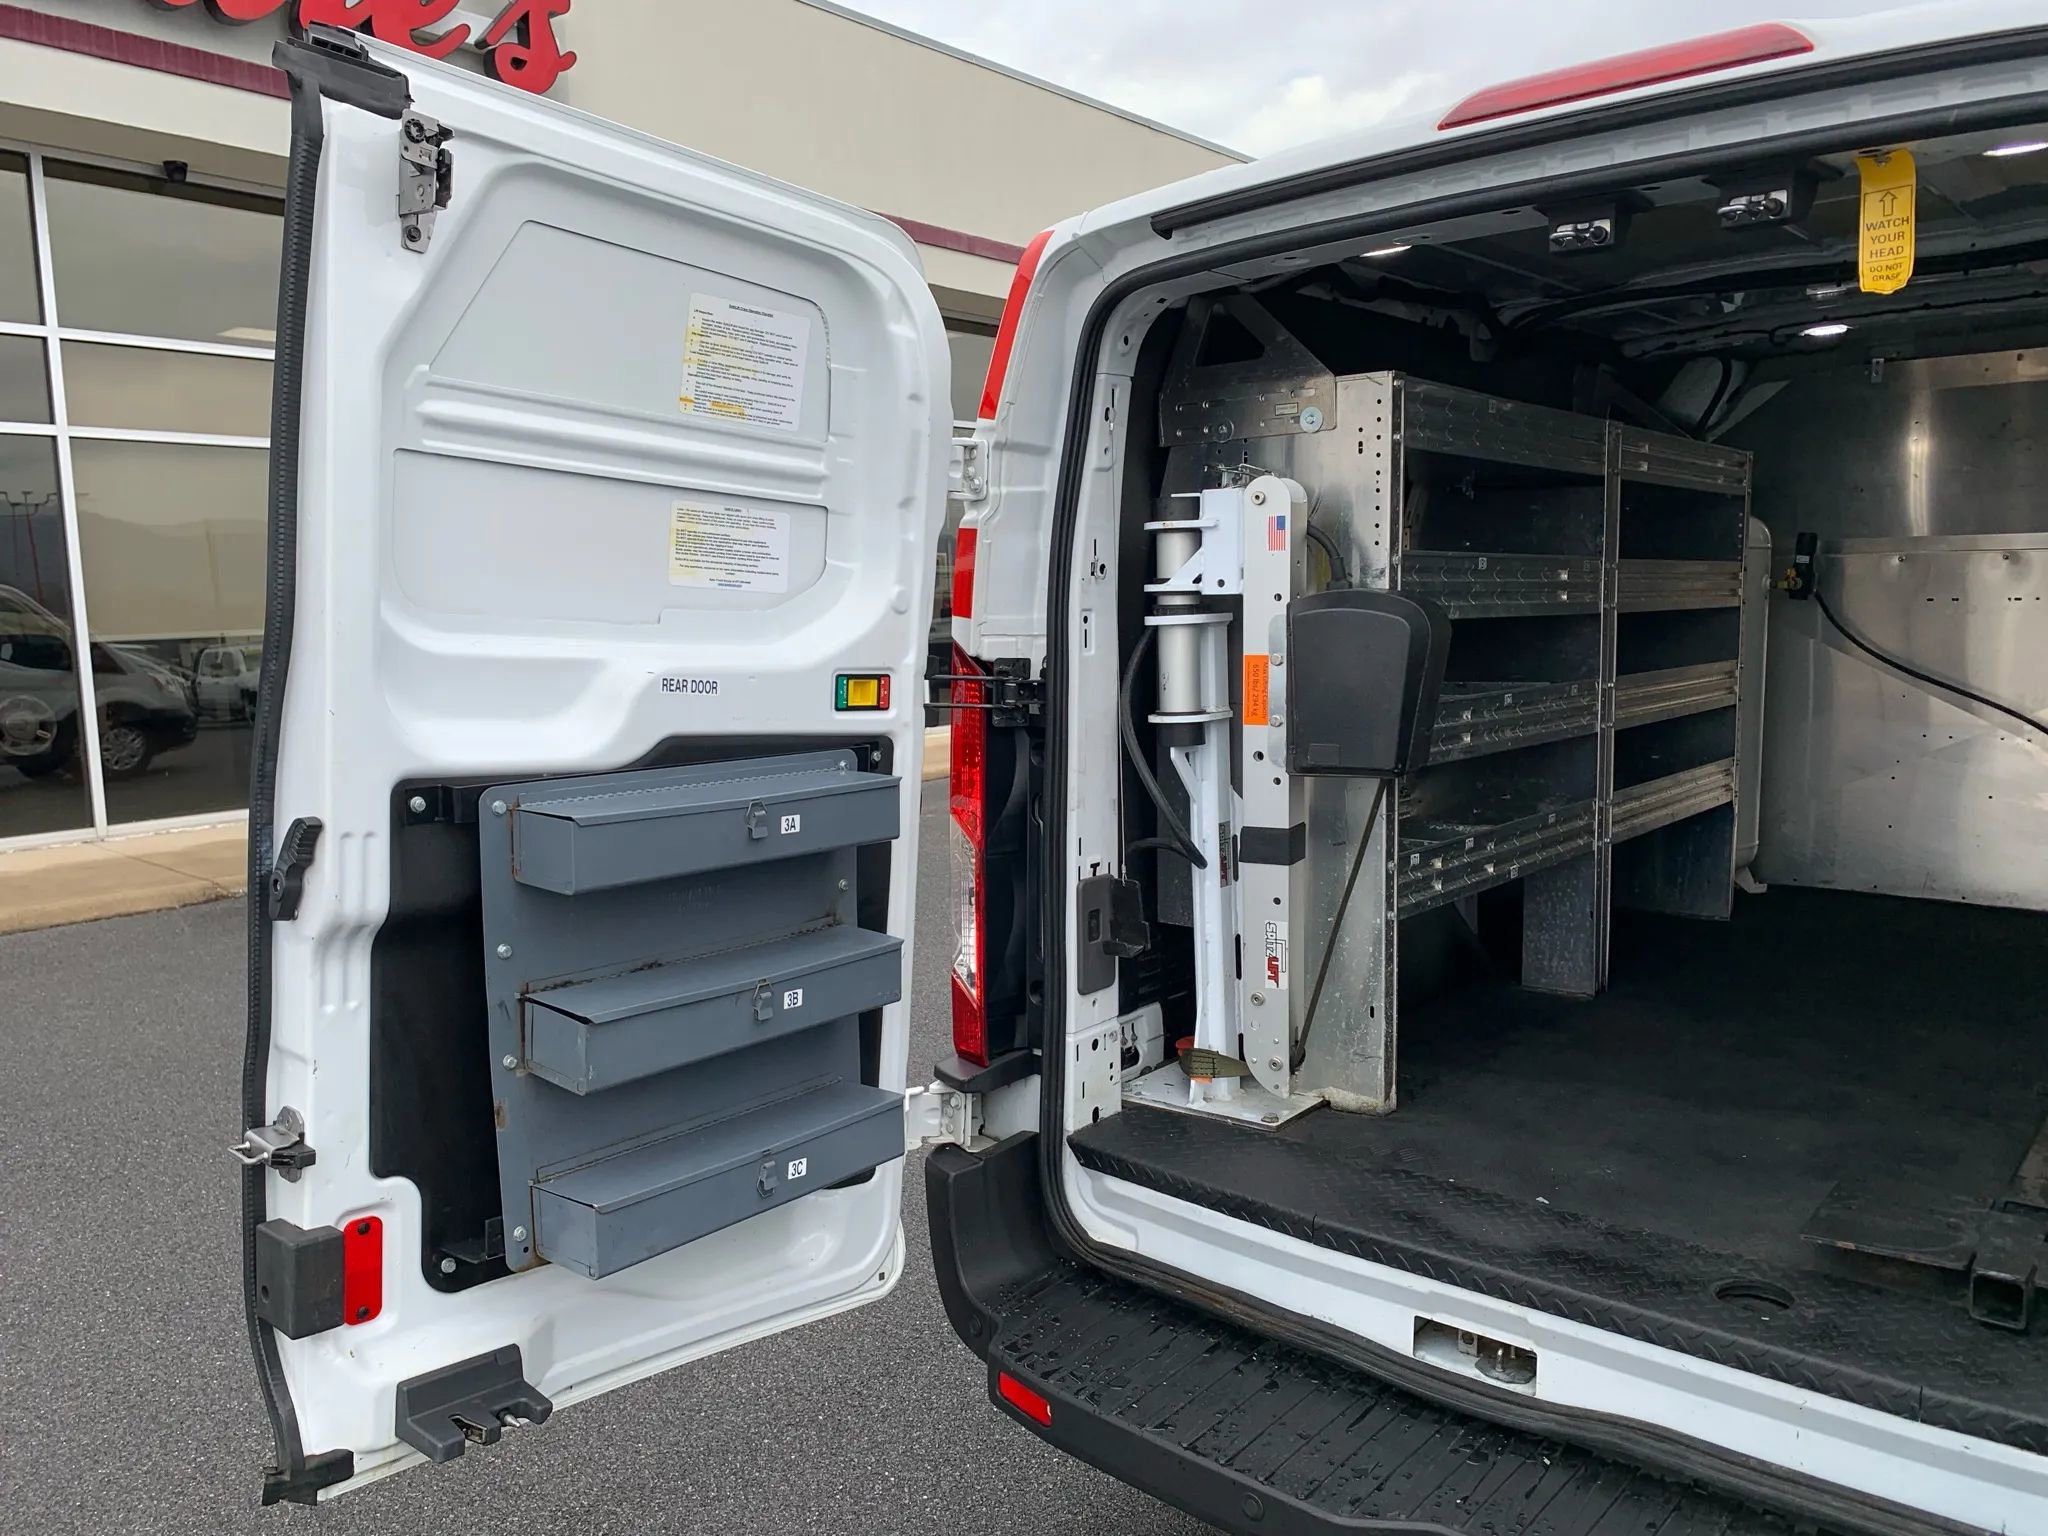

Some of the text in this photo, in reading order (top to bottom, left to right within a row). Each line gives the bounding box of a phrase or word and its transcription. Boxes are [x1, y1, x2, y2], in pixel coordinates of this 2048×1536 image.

[1866, 216, 1909, 232] WATCH
[1870, 231, 1905, 245] YOUR
[1870, 245, 1904, 259] HEAD
[1885, 263, 1903, 271] NOT
[1252, 664, 1260, 678] 650
[661, 677, 718, 695] REAR DOOR
[785, 817, 796, 832] 3A
[787, 992, 799, 1006] 3B
[791, 1160, 803, 1176] 3C
